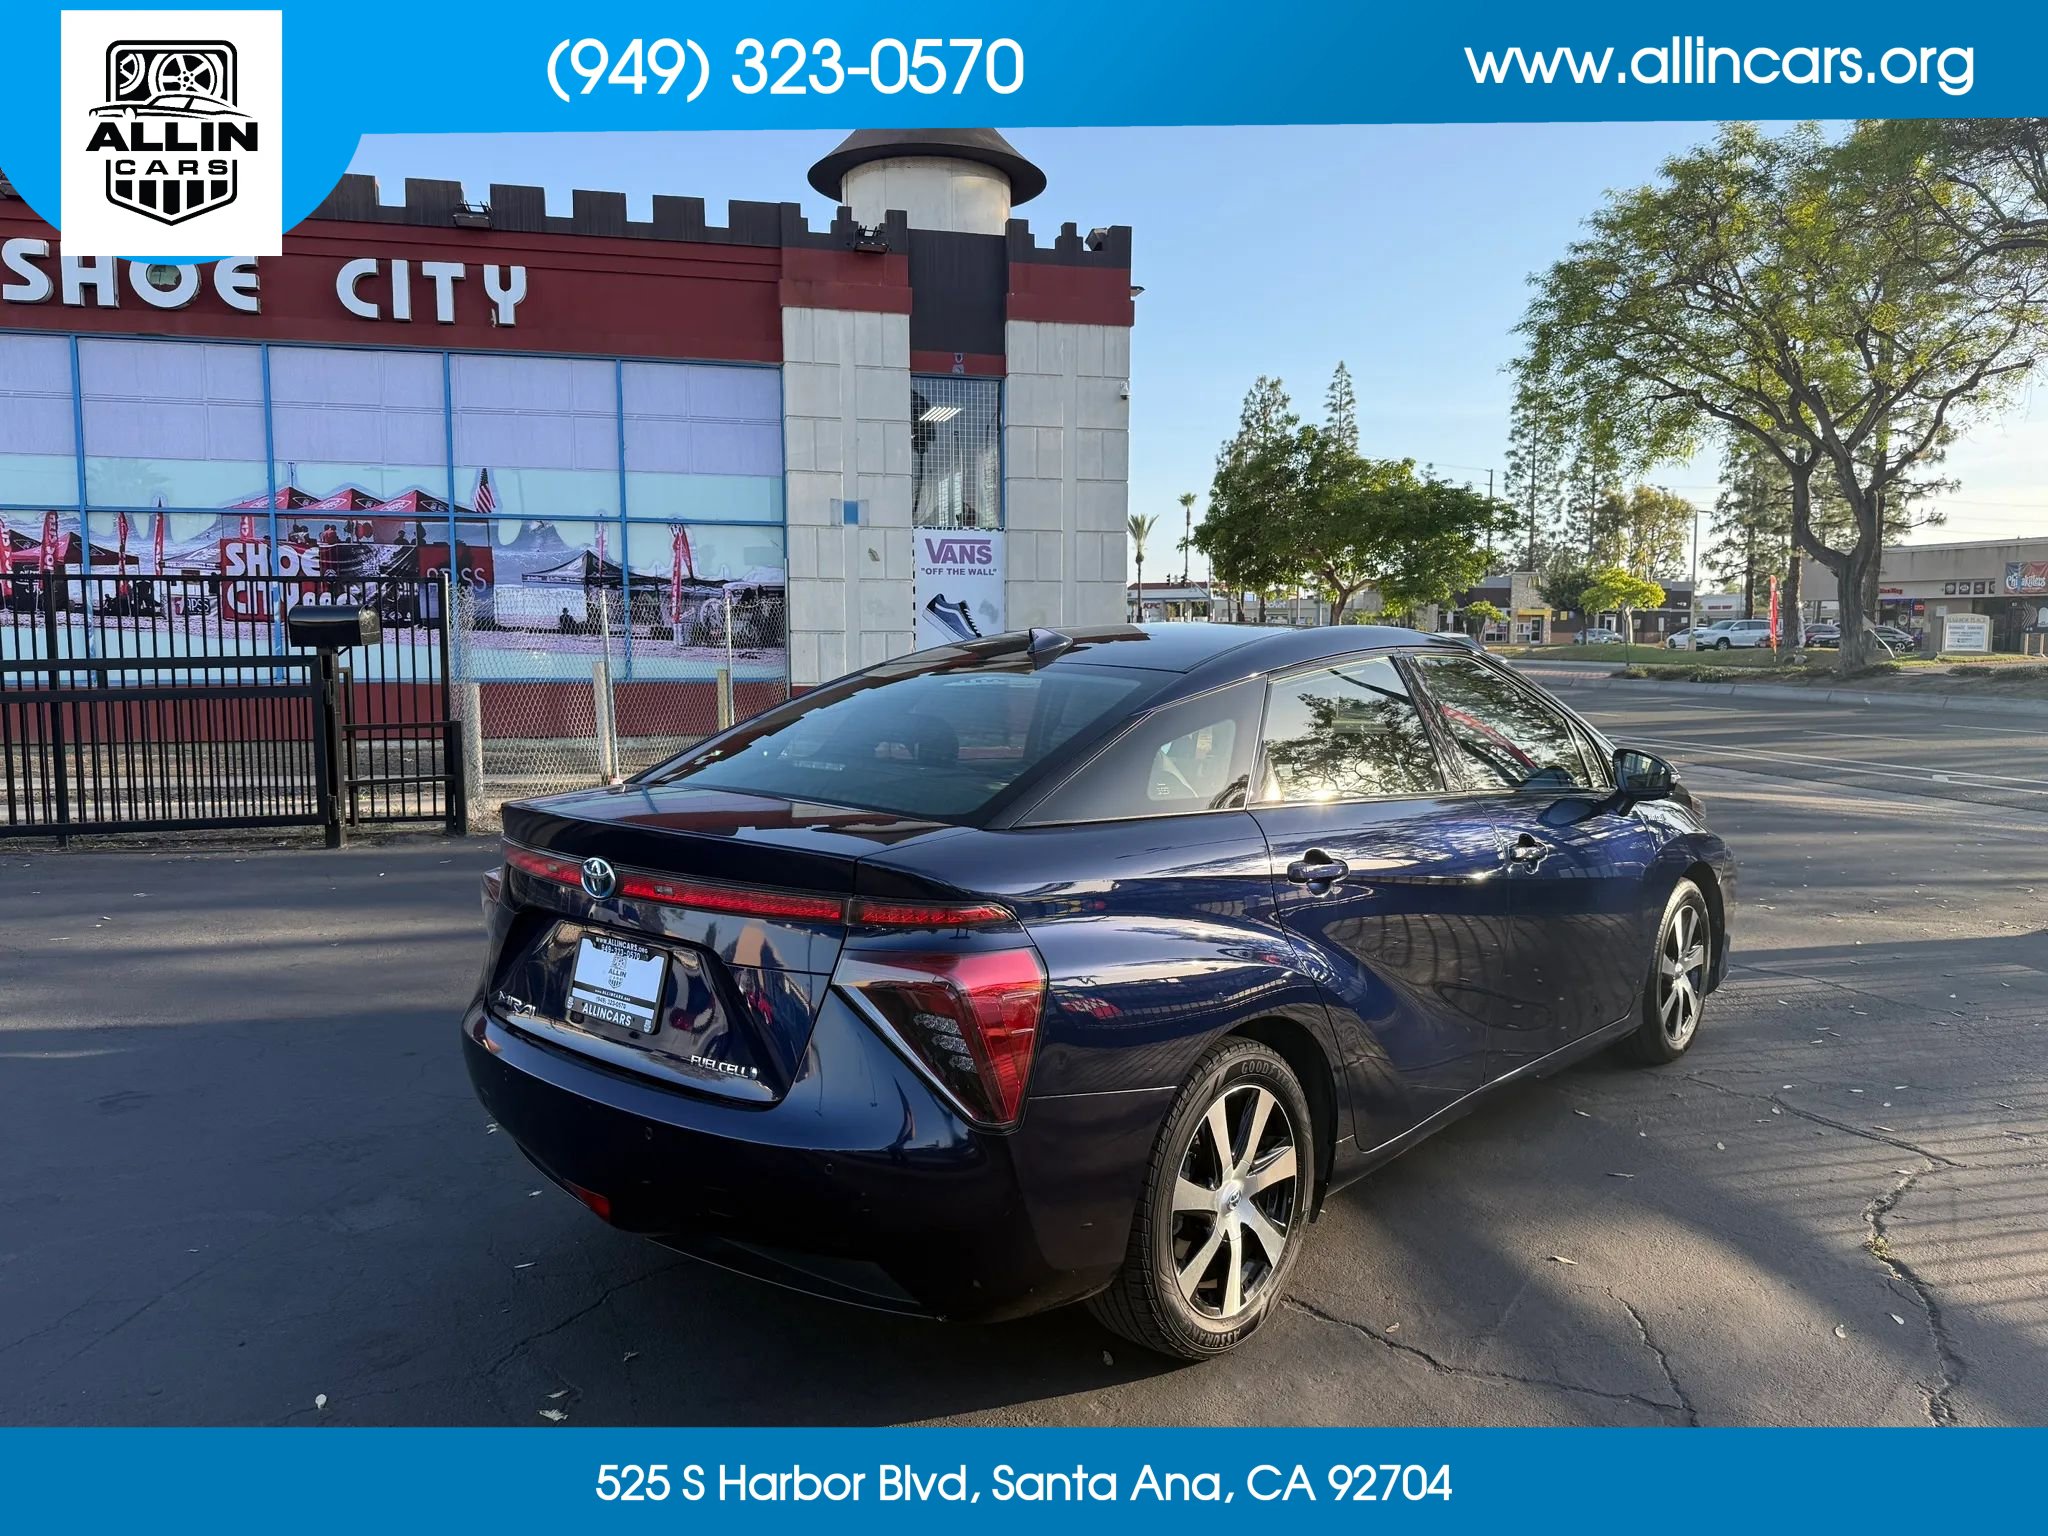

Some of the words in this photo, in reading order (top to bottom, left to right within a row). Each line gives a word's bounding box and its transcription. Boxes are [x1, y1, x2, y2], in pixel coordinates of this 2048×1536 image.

[1, 237, 261, 314] SHOE
[336, 257, 528, 327] CITY
[225, 543, 320, 577] SHOE
[925, 538, 993, 565] VANS
[921, 567, 944, 576] "OFF
[946, 568, 966, 576] THE
[968, 568, 997, 577] WALL"
[582, 1002, 632, 1026] ALLINCARS
